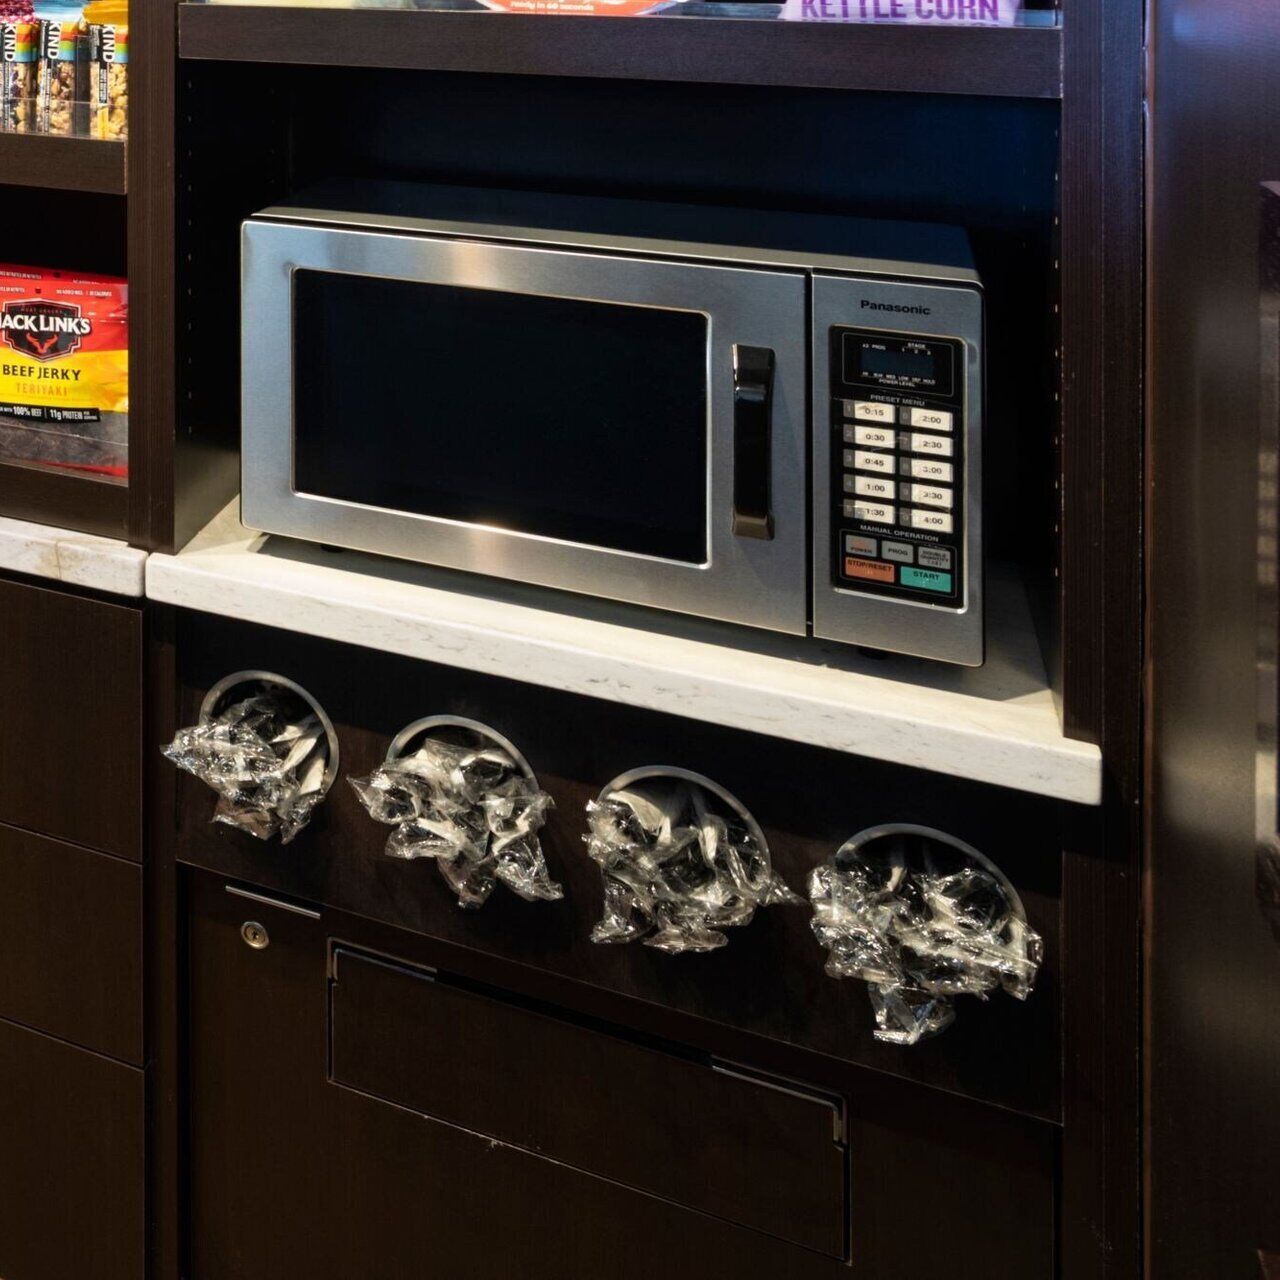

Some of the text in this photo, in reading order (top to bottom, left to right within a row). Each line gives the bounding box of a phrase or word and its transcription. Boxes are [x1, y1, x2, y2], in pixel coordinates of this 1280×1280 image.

[4, 22, 16, 62] KIND
[47, 21, 61, 60] KIND
[103, 25, 116, 63] KIND
[860, 299, 931, 315] Panasonic
[39, 315, 91, 335] LINK'S
[2, 364, 82, 381] BEEF JERKY
[16, 382, 68, 397] TERIYAKI
[870, 394, 925, 406] PRESET MENU
[13, 406, 42, 417] 100% BEEF
[50, 409, 83, 421] 11g PROTEIN
[865, 408, 884, 416] 0:15
[923, 415, 942, 424] 2:00
[865, 433, 885, 441] 0:30
[923, 441, 942, 449] 2:30
[865, 458, 884, 466] 0:45
[866, 483, 885, 492] 1:00
[923, 491, 943, 499] 3:30
[866, 508, 885, 516] 1:30
[924, 516, 943, 525] 4:00
[860, 524, 939, 542] MANUAL OPERATION
[888, 548, 908, 556] PROG
[848, 559, 893, 572] STOP/RESET
[913, 571, 940, 580] START
